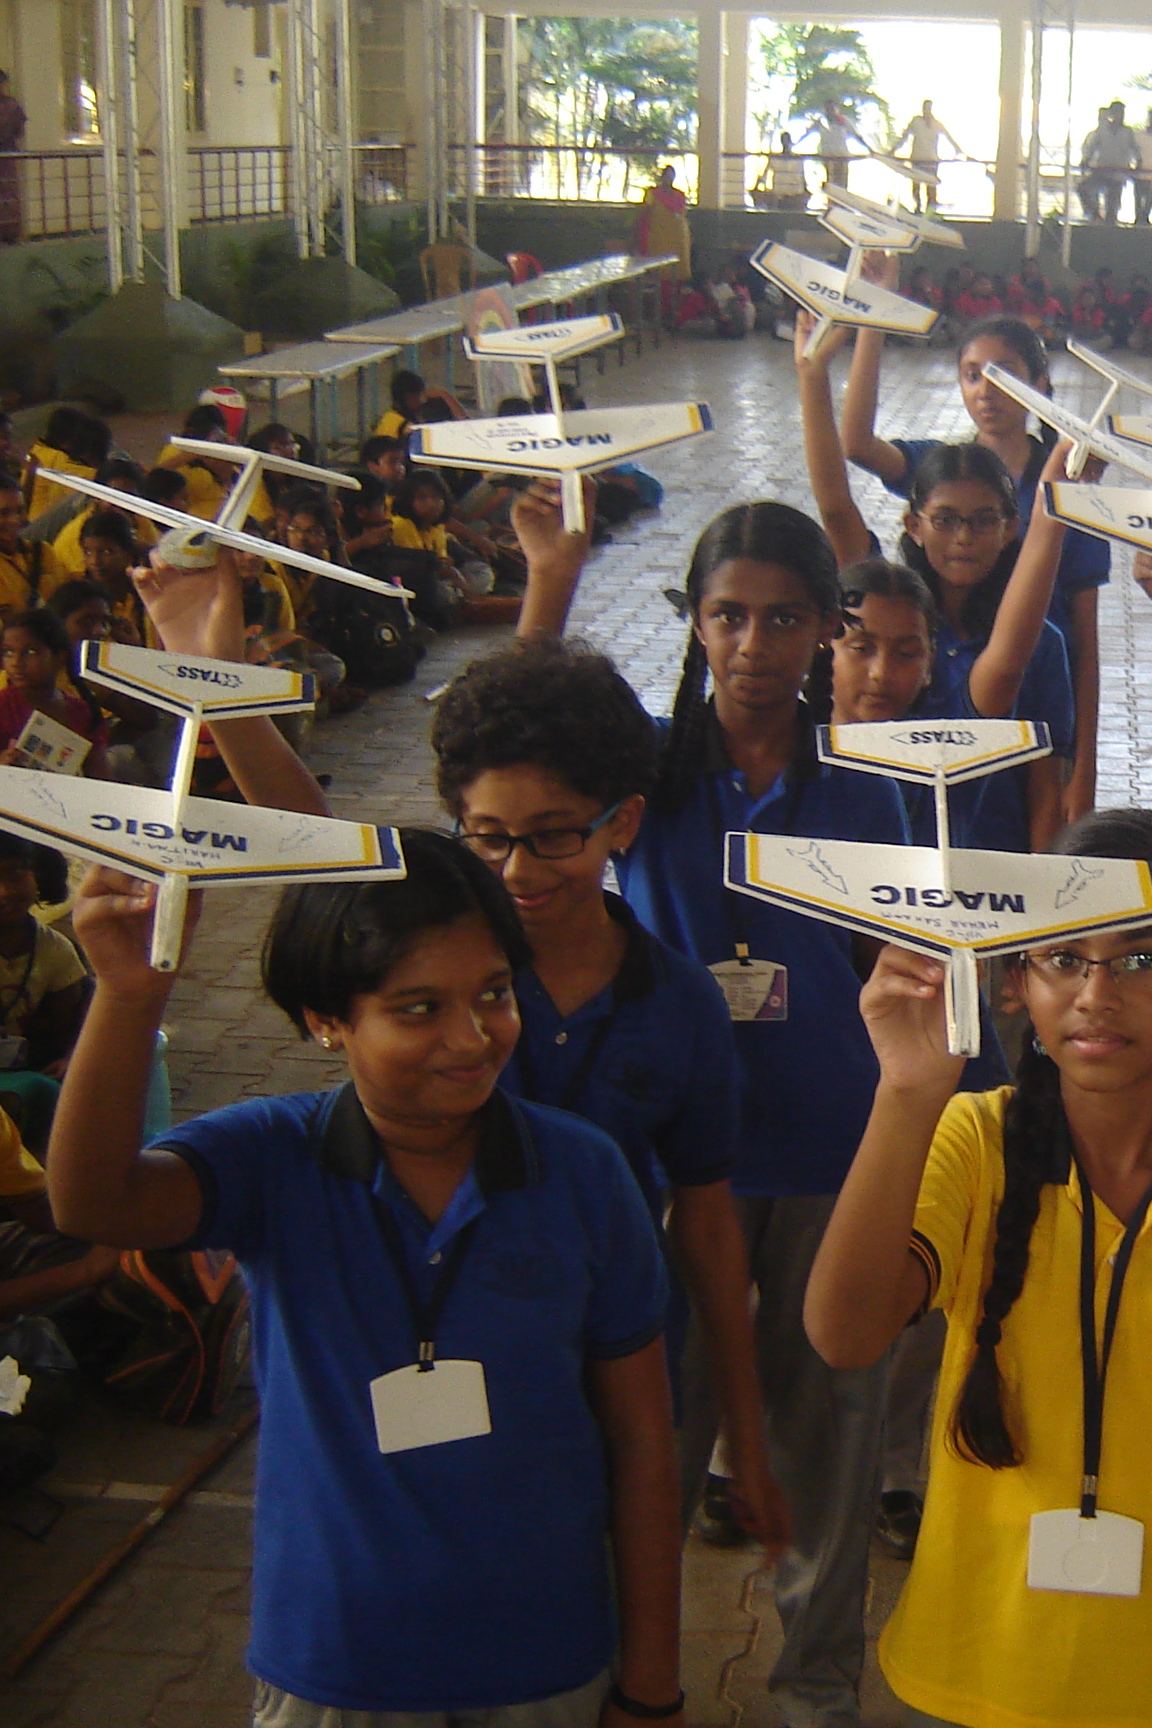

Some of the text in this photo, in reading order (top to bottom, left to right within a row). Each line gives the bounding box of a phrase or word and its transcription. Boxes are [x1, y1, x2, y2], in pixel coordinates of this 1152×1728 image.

[806, 281, 872, 314] MAGIC
[507, 433, 613, 453] MAGIC
[91, 814, 249, 852] MAGIC
[870, 885, 1026, 914] MAGIC
